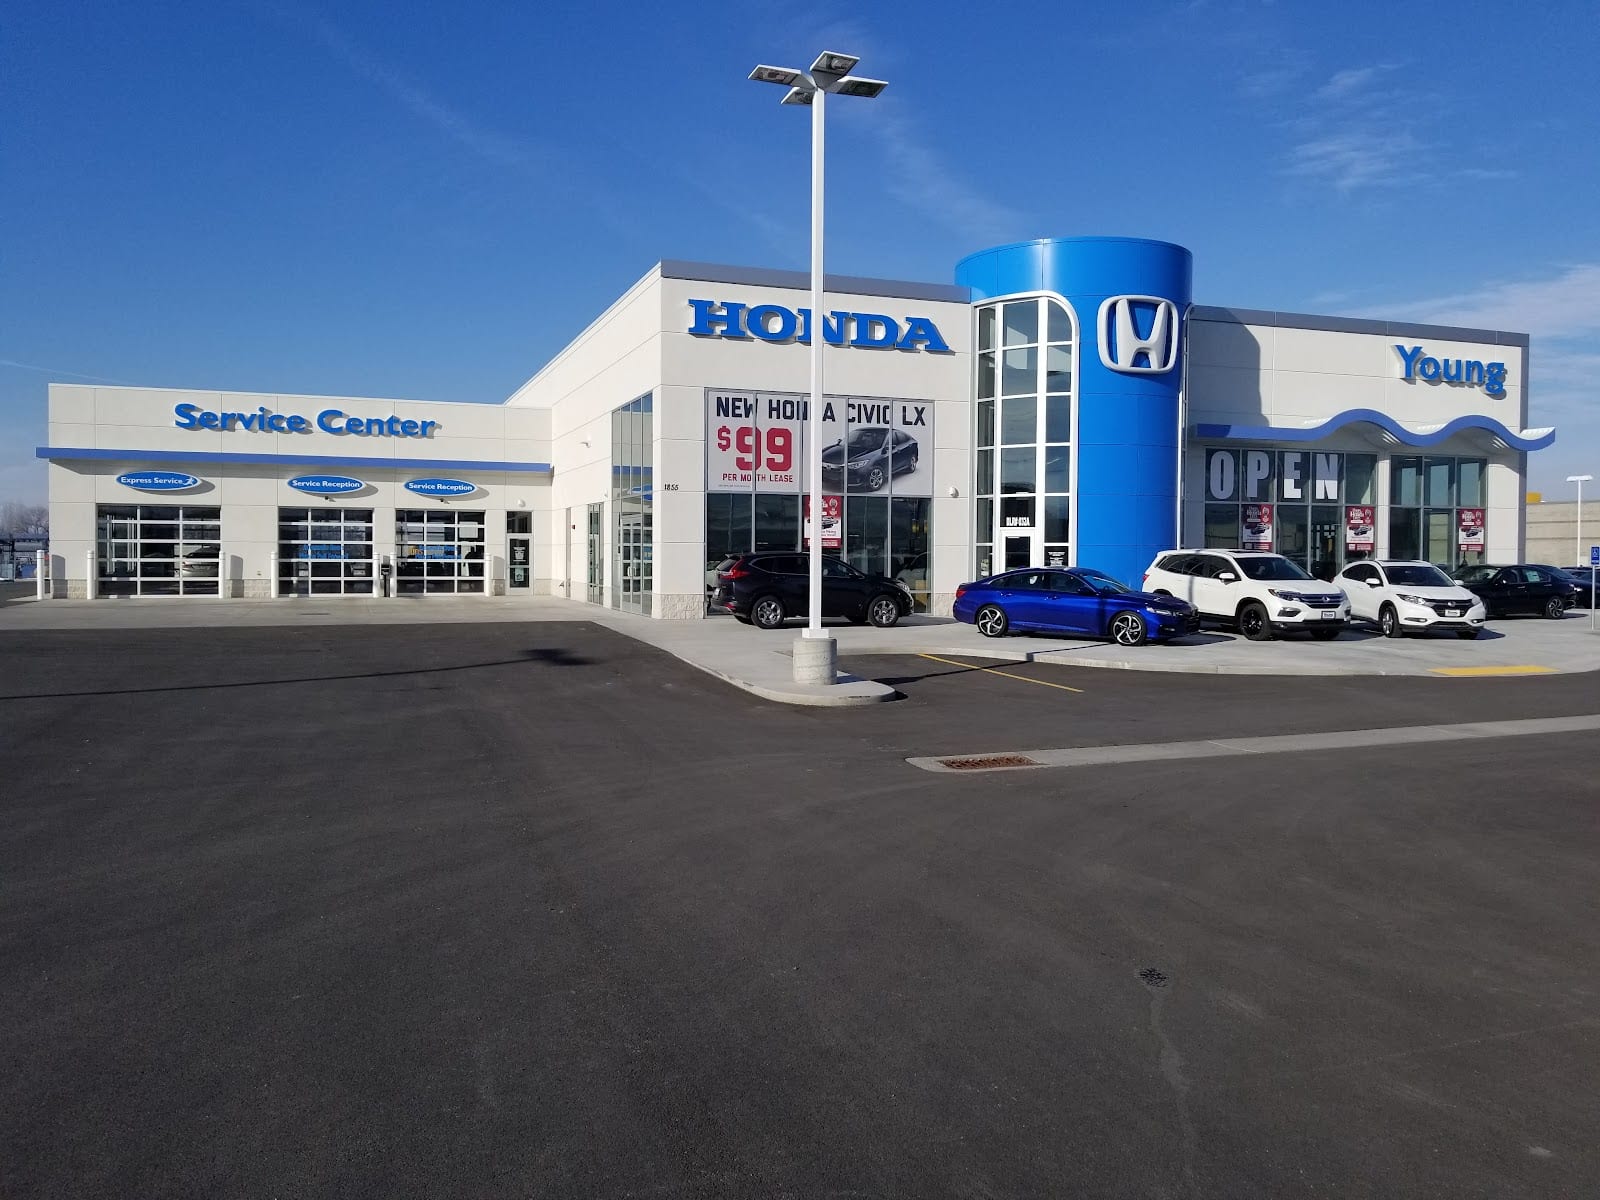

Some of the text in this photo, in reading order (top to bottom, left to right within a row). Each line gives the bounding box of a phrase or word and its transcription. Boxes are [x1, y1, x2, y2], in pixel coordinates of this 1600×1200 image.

[688, 299, 950, 351] HONDA
[1395, 344, 1505, 394] Young
[174, 403, 436, 436] Service Center
[716, 396, 759, 419] NEW
[768, 399, 836, 422] HONA
[902, 406, 926, 426] LX
[717, 425, 793, 472] $99
[121, 476, 152, 484] Express
[322, 480, 360, 488] Reception
[436, 483, 473, 491] Reception
[664, 483, 679, 491] 1855
[722, 473, 793, 483] PER MOTH LEASE
[1209, 450, 1338, 500] OPEN
